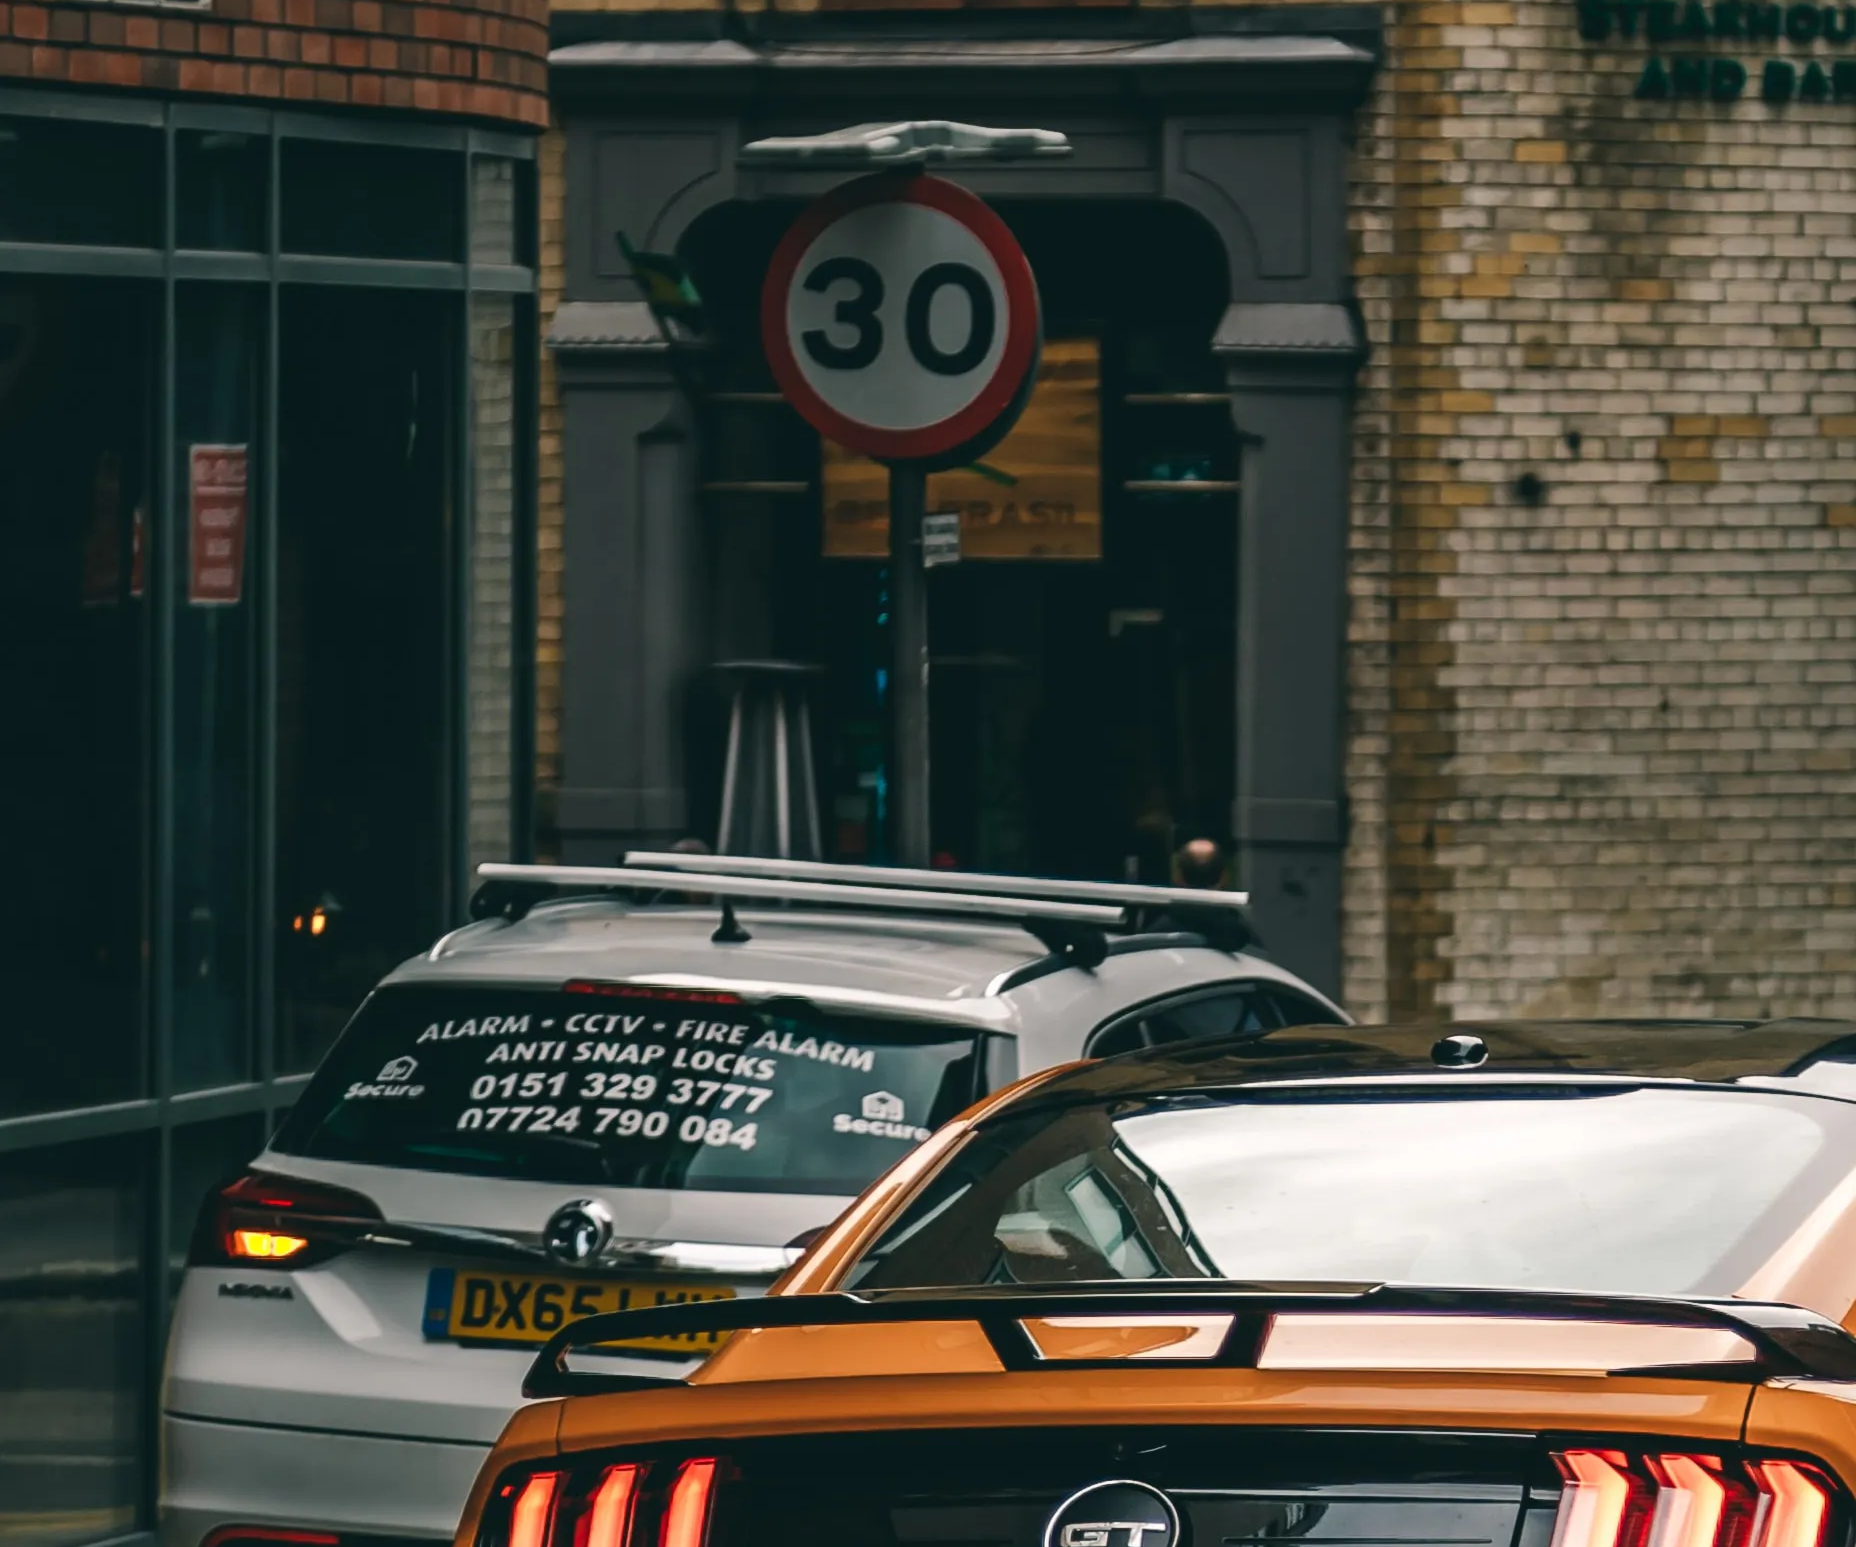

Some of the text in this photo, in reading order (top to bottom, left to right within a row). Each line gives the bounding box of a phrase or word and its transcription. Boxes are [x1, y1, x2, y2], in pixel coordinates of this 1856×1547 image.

[1635, 57, 1748, 103] AND
[801, 256, 996, 377] 30
[416, 1013, 876, 1073] ALARM CCTV FIRE ALARM
[485, 1041, 777, 1082] ANTI SNAP LOCKS
[344, 1082, 425, 1100] Secure
[470, 1072, 774, 1114] 0151 329 3777
[456, 1106, 758, 1151] 07724 790 084
[832, 1113, 932, 1142] Secure
[460, 1278, 605, 1330] DX65
[1060, 1522, 1166, 1547] GT
